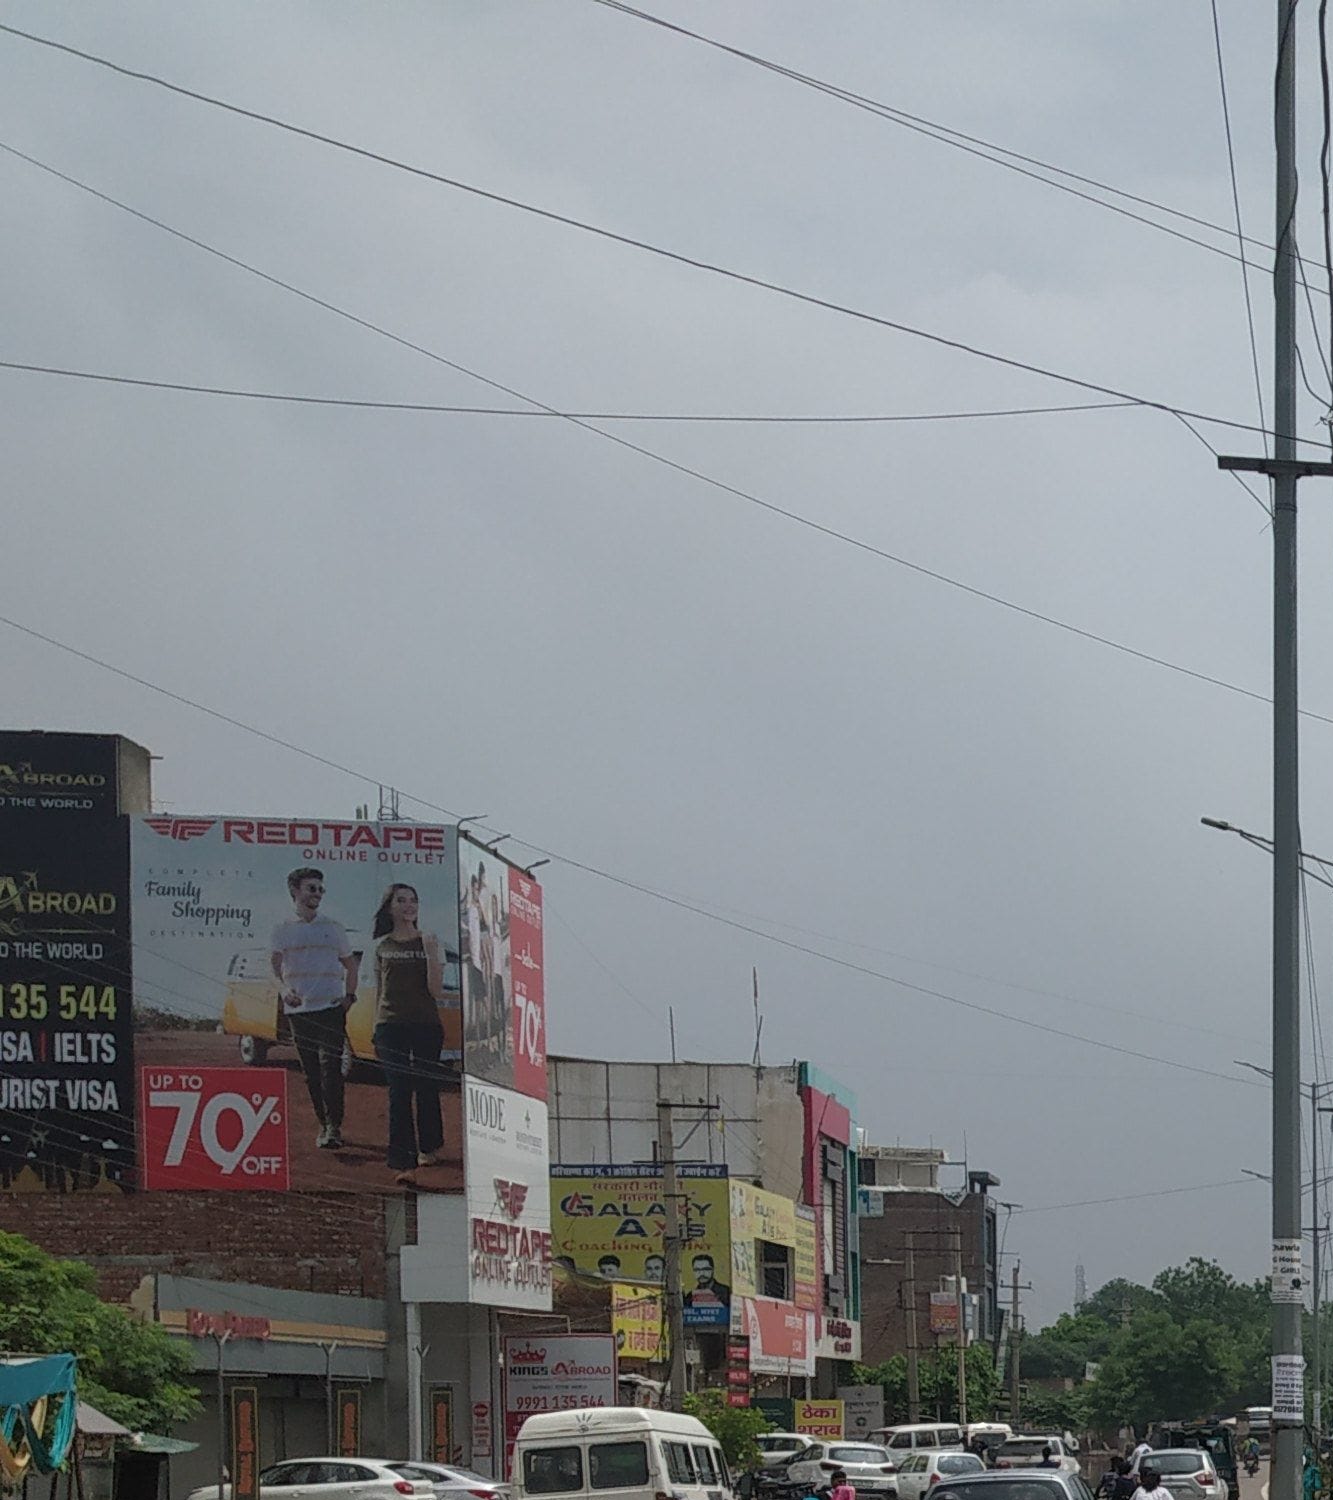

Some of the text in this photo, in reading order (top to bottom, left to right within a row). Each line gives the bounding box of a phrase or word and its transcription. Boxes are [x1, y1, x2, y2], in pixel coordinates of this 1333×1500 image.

[40, 799, 94, 809] WORLD
[222, 819, 446, 851] REDTAPE
[302, 848, 446, 865] ONLINE OUTLET
[144, 880, 202, 904] Family
[171, 900, 252, 927] Shopping
[13, 942, 104, 960] THE WORLD
[59, 984, 118, 1021] 544
[54, 1031, 117, 1064] IELTS
[150, 1074, 204, 1090] UP TO
[65, 1079, 120, 1111] VISA
[468, 1087, 507, 1133] MODE
[149, 1091, 282, 1175] 70%
[242, 1156, 283, 1176] OFF
[472, 1217, 552, 1264] REDTAPE
[509, 1362, 612, 1376] KINGS ABROAD
[516, 1395, 605, 1410] 9991 135 544
[802, 1404, 838, 1419] ठेका
